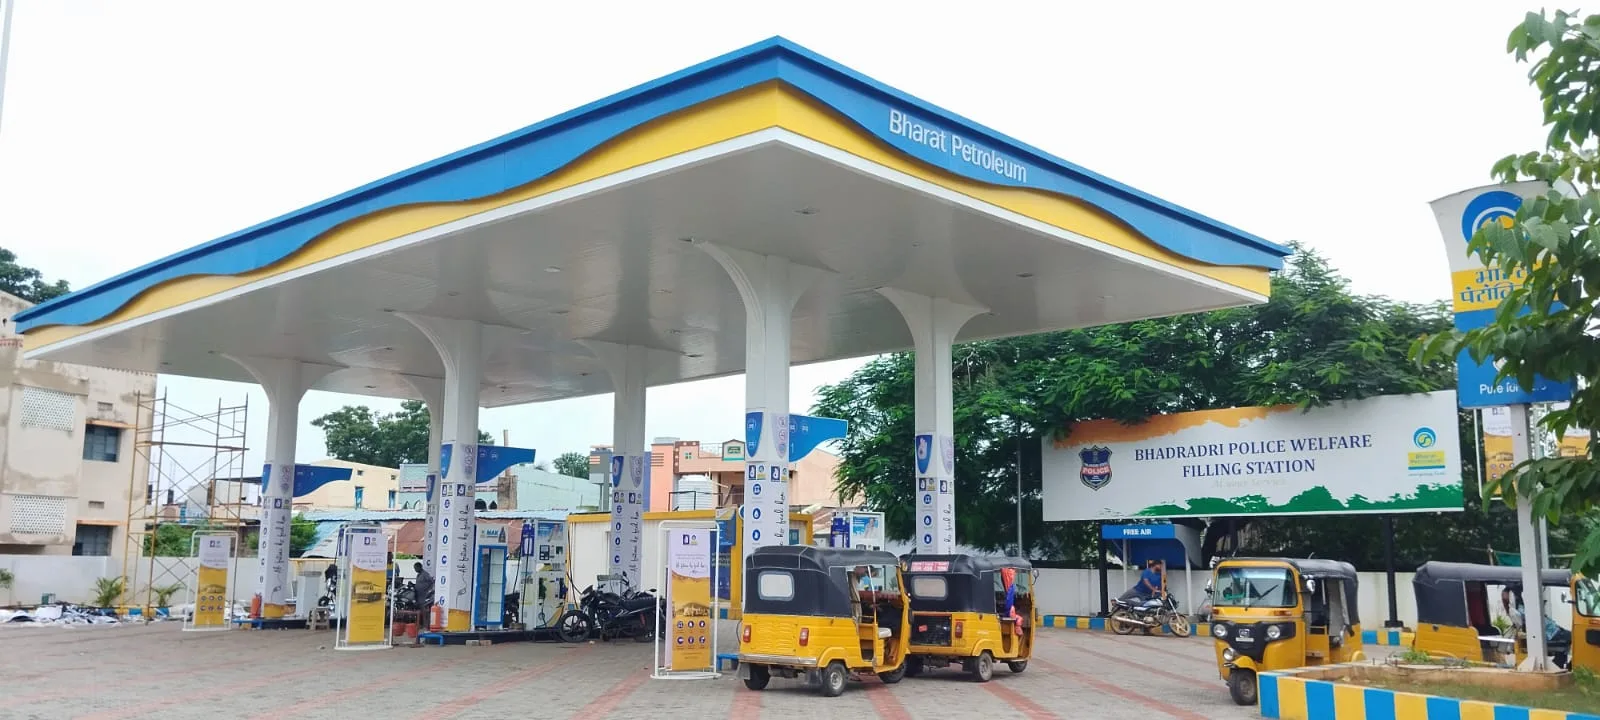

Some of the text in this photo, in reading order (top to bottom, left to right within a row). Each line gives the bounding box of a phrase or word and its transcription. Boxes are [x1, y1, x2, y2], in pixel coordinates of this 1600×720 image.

[889, 108, 1027, 183] Bharat Petroleum
[1135, 434, 1372, 461] BHADRADRI POLICE WELFARE
[1183, 458, 1316, 478] FILLING STATION
[1123, 528, 1152, 536] FREE AIR
